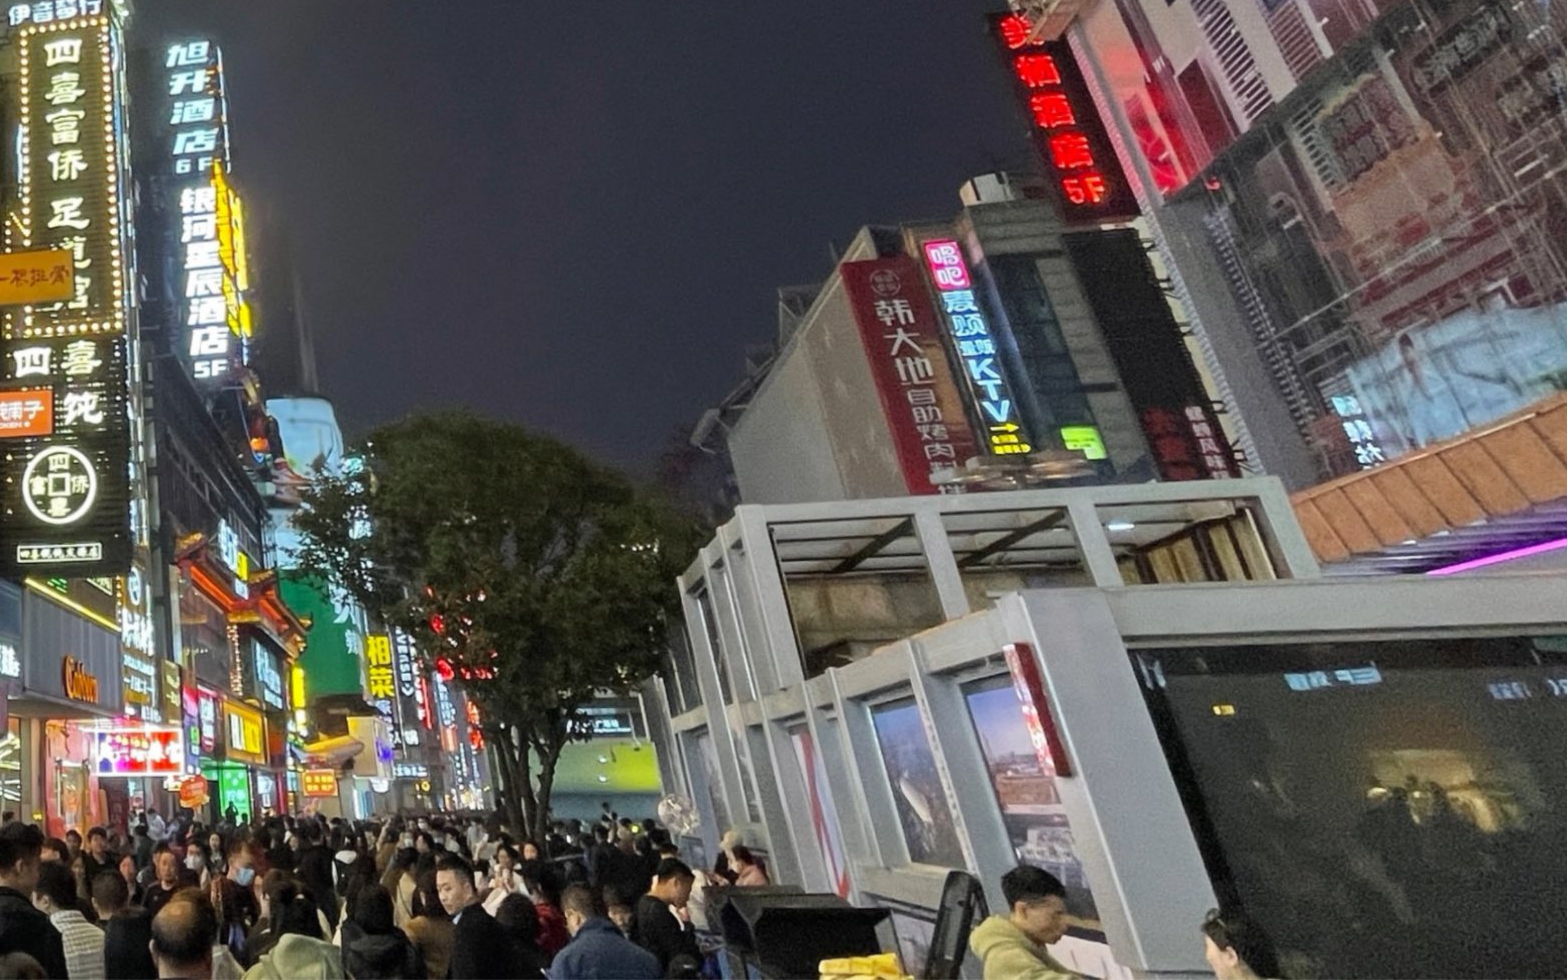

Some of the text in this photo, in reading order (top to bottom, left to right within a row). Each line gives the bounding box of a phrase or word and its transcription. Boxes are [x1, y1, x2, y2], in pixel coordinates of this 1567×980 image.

[1063, 176, 1107, 204] 5F
[180, 187, 231, 358] 银河星辰酒店
[12, 339, 105, 379] 四喜
[874, 299, 936, 386] 韩大地
